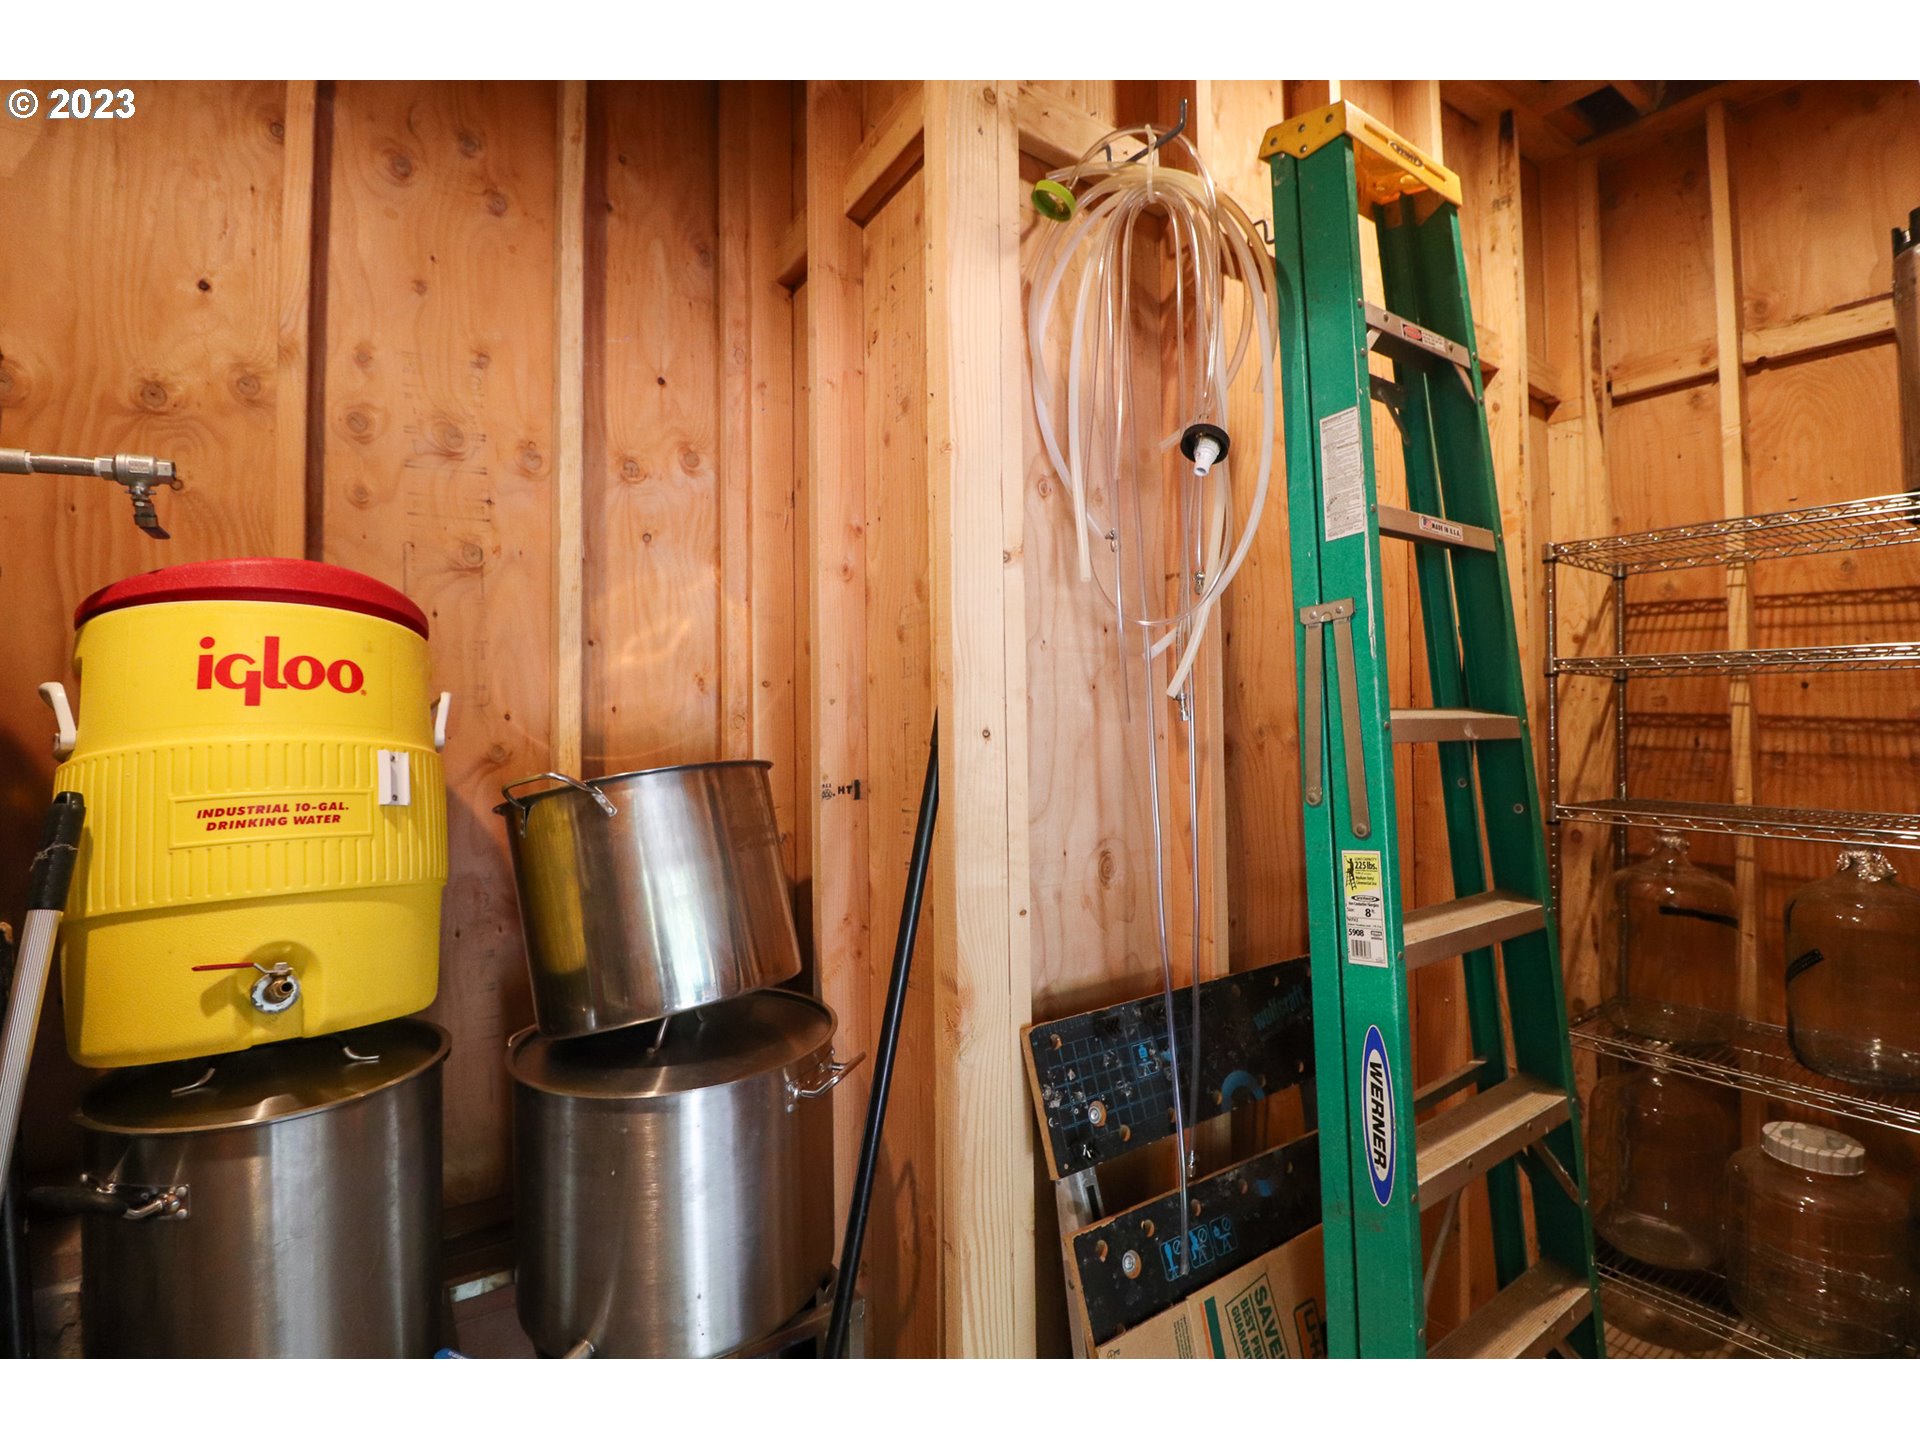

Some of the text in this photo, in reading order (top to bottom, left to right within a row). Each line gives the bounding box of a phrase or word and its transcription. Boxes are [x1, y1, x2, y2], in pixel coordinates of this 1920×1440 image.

[196, 635, 365, 707] igloo
[196, 801, 350, 820] INDUSTRIAL 10-GAL.
[206, 814, 342, 831] DRINKING WATER
[1354, 861, 1367, 870] 225
[1365, 908, 1371, 917] 8
[1348, 928, 1365, 937] 5908
[1369, 1061, 1387, 1170] WERNER
[1240, 1296, 1257, 1334] BEST
